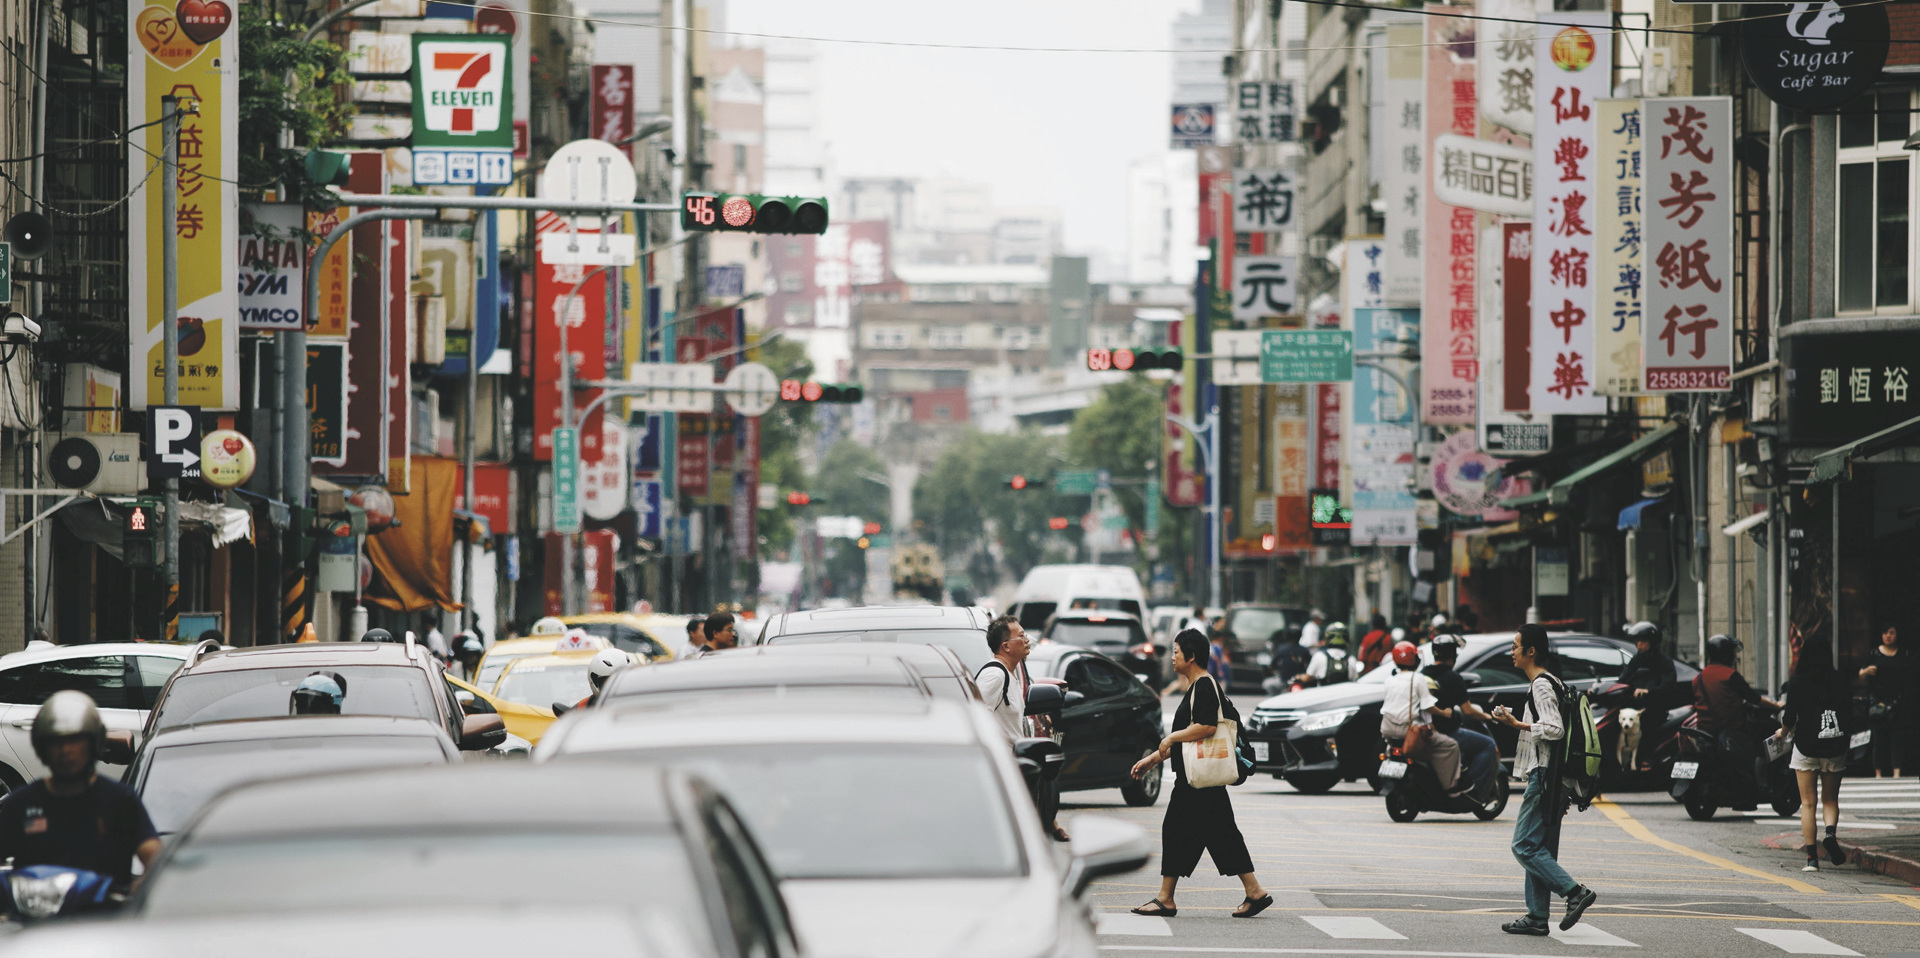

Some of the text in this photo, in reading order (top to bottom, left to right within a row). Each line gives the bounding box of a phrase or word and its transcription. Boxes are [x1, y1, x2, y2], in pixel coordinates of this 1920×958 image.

[1777, 49, 1854, 72] Sugar
[434, 52, 491, 132] 7
[1822, 74, 1851, 87] Bar
[686, 196, 716, 225] 46
[1238, 171, 1293, 226] 菊
[1547, 86, 1594, 400] 仙豐濃縮中藥
[1655, 105, 1722, 360] 茂芳紙行
[238, 235, 299, 269] AHA
[1240, 263, 1292, 313] 元
[154, 364, 219, 377] 台彩券
[1649, 371, 1728, 388] 25583216
[155, 408, 194, 455] P
[181, 469, 200, 478] 24H
